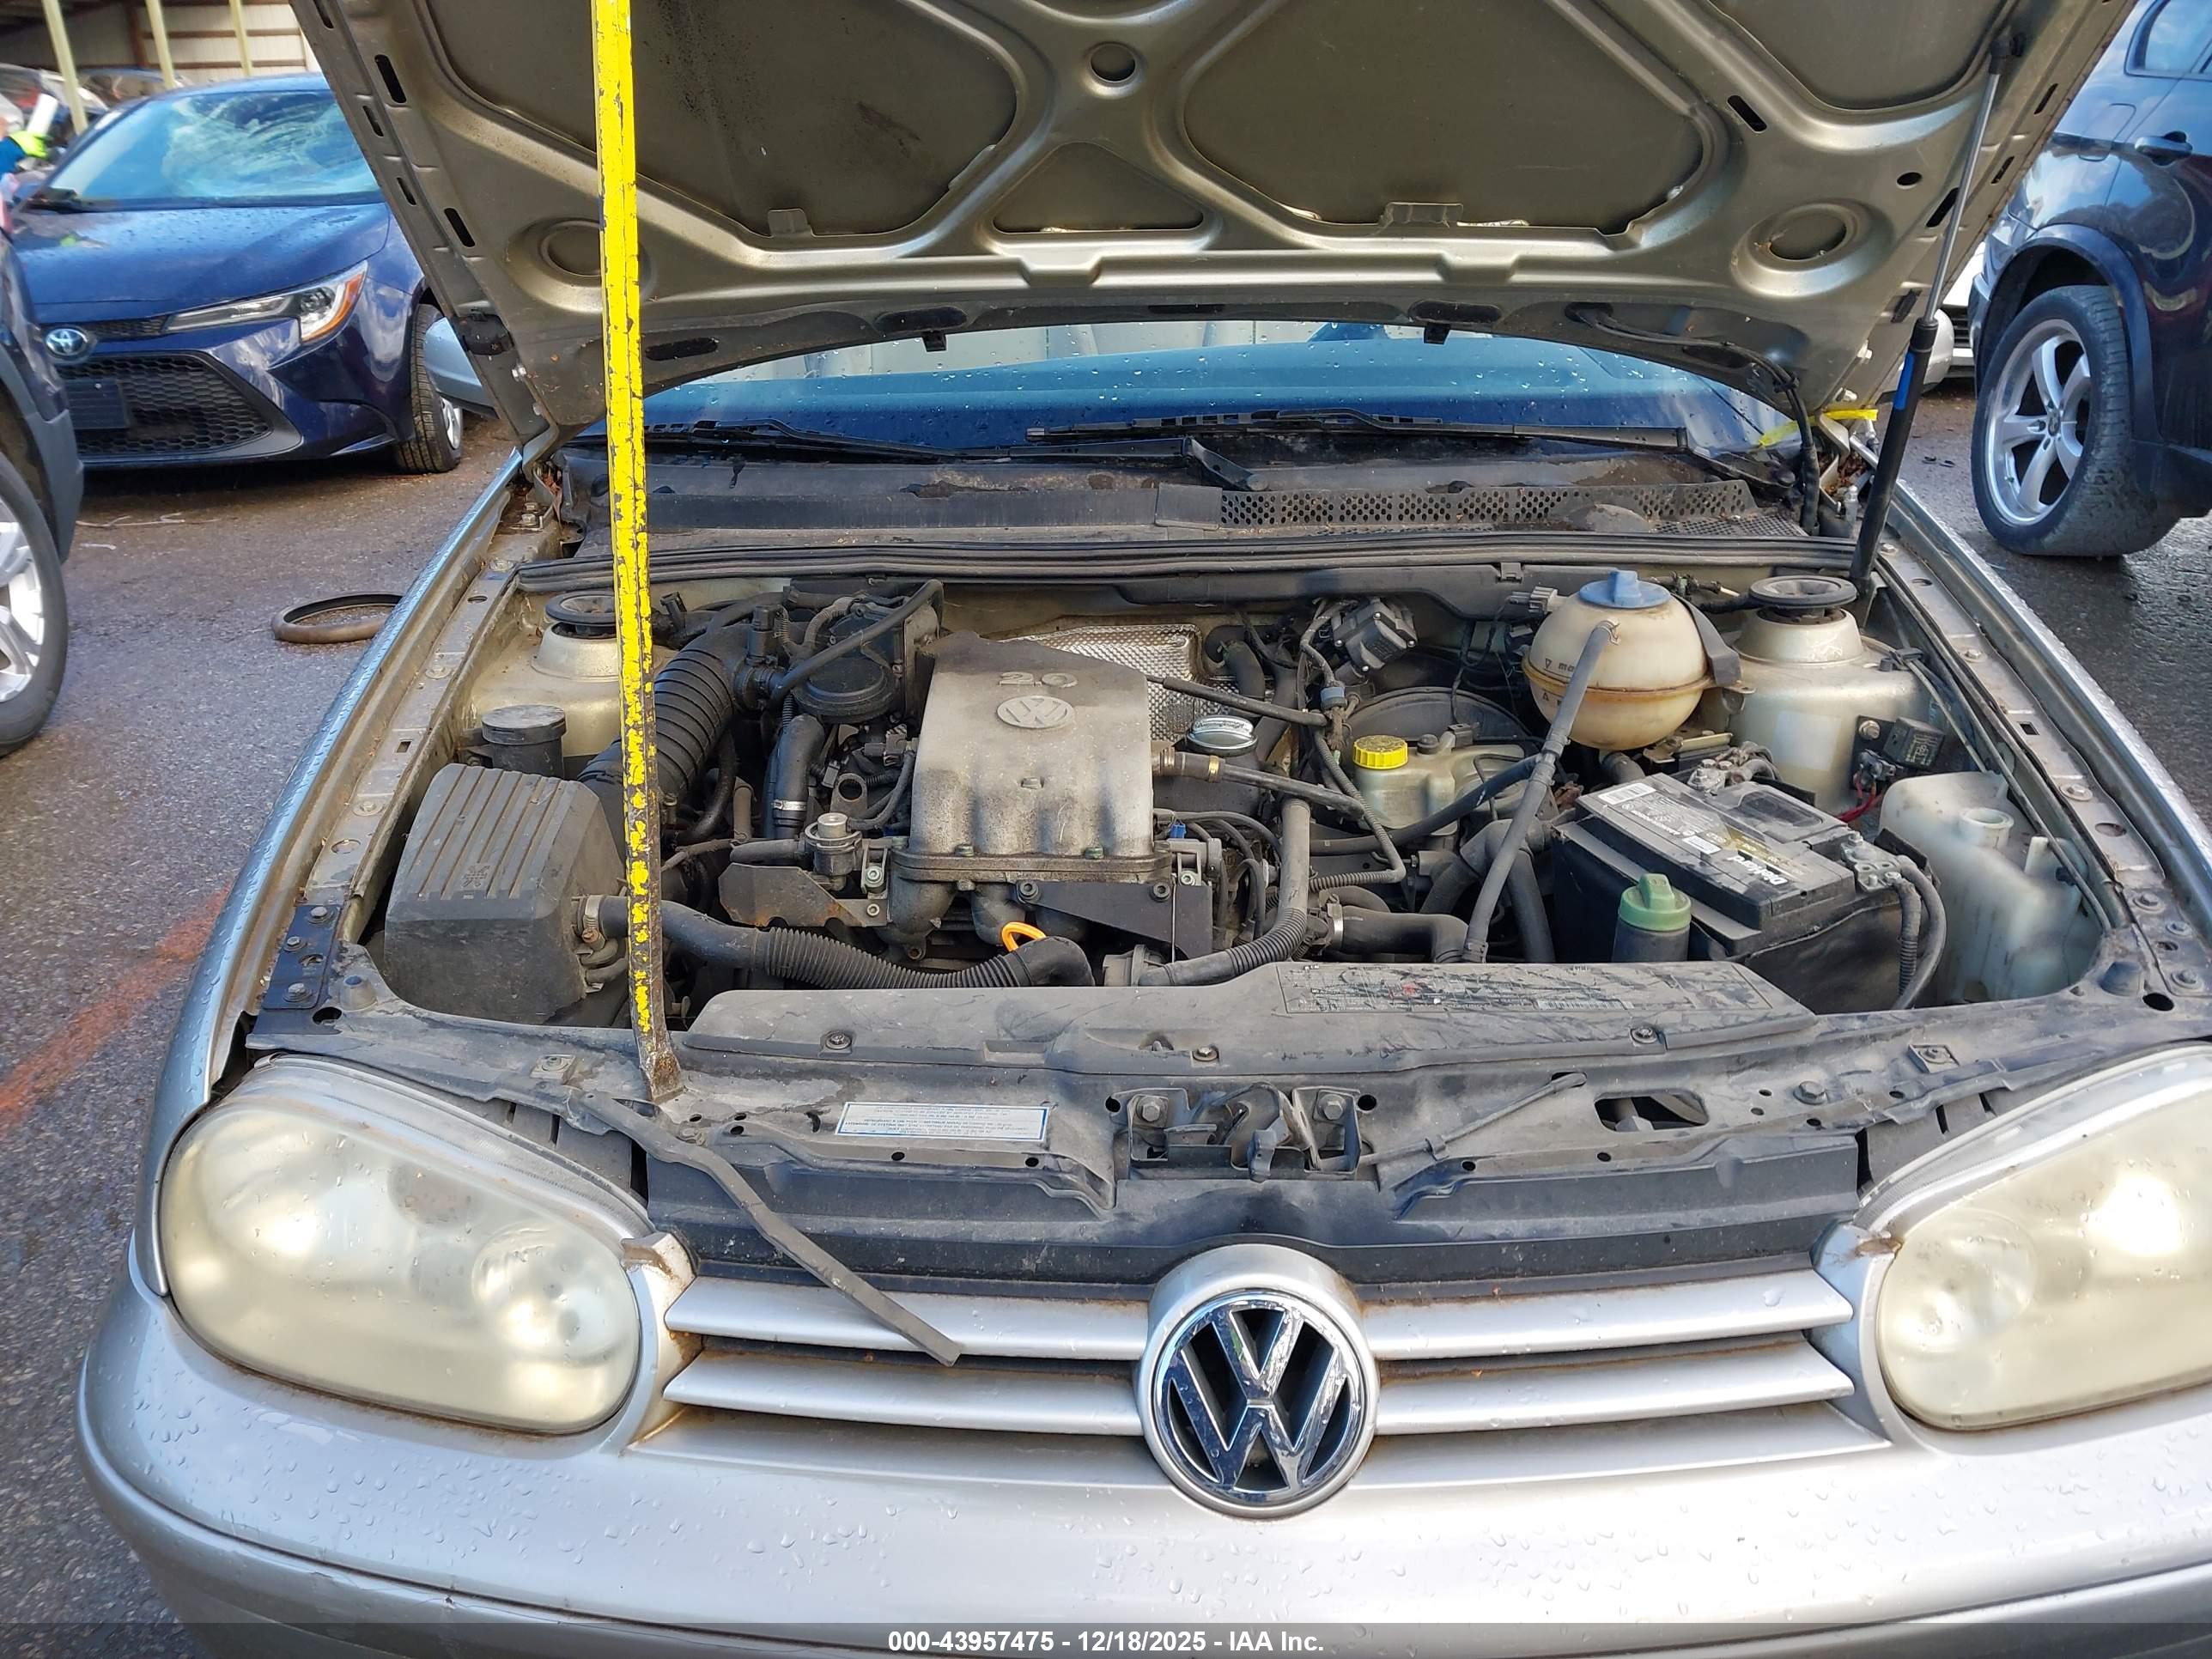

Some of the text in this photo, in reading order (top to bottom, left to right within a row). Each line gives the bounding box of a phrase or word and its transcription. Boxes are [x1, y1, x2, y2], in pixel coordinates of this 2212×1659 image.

[998, 672, 1079, 688] 2.0
[1726, 854, 1789, 885] DieHard
[1159, 1292, 1366, 1501] VW
